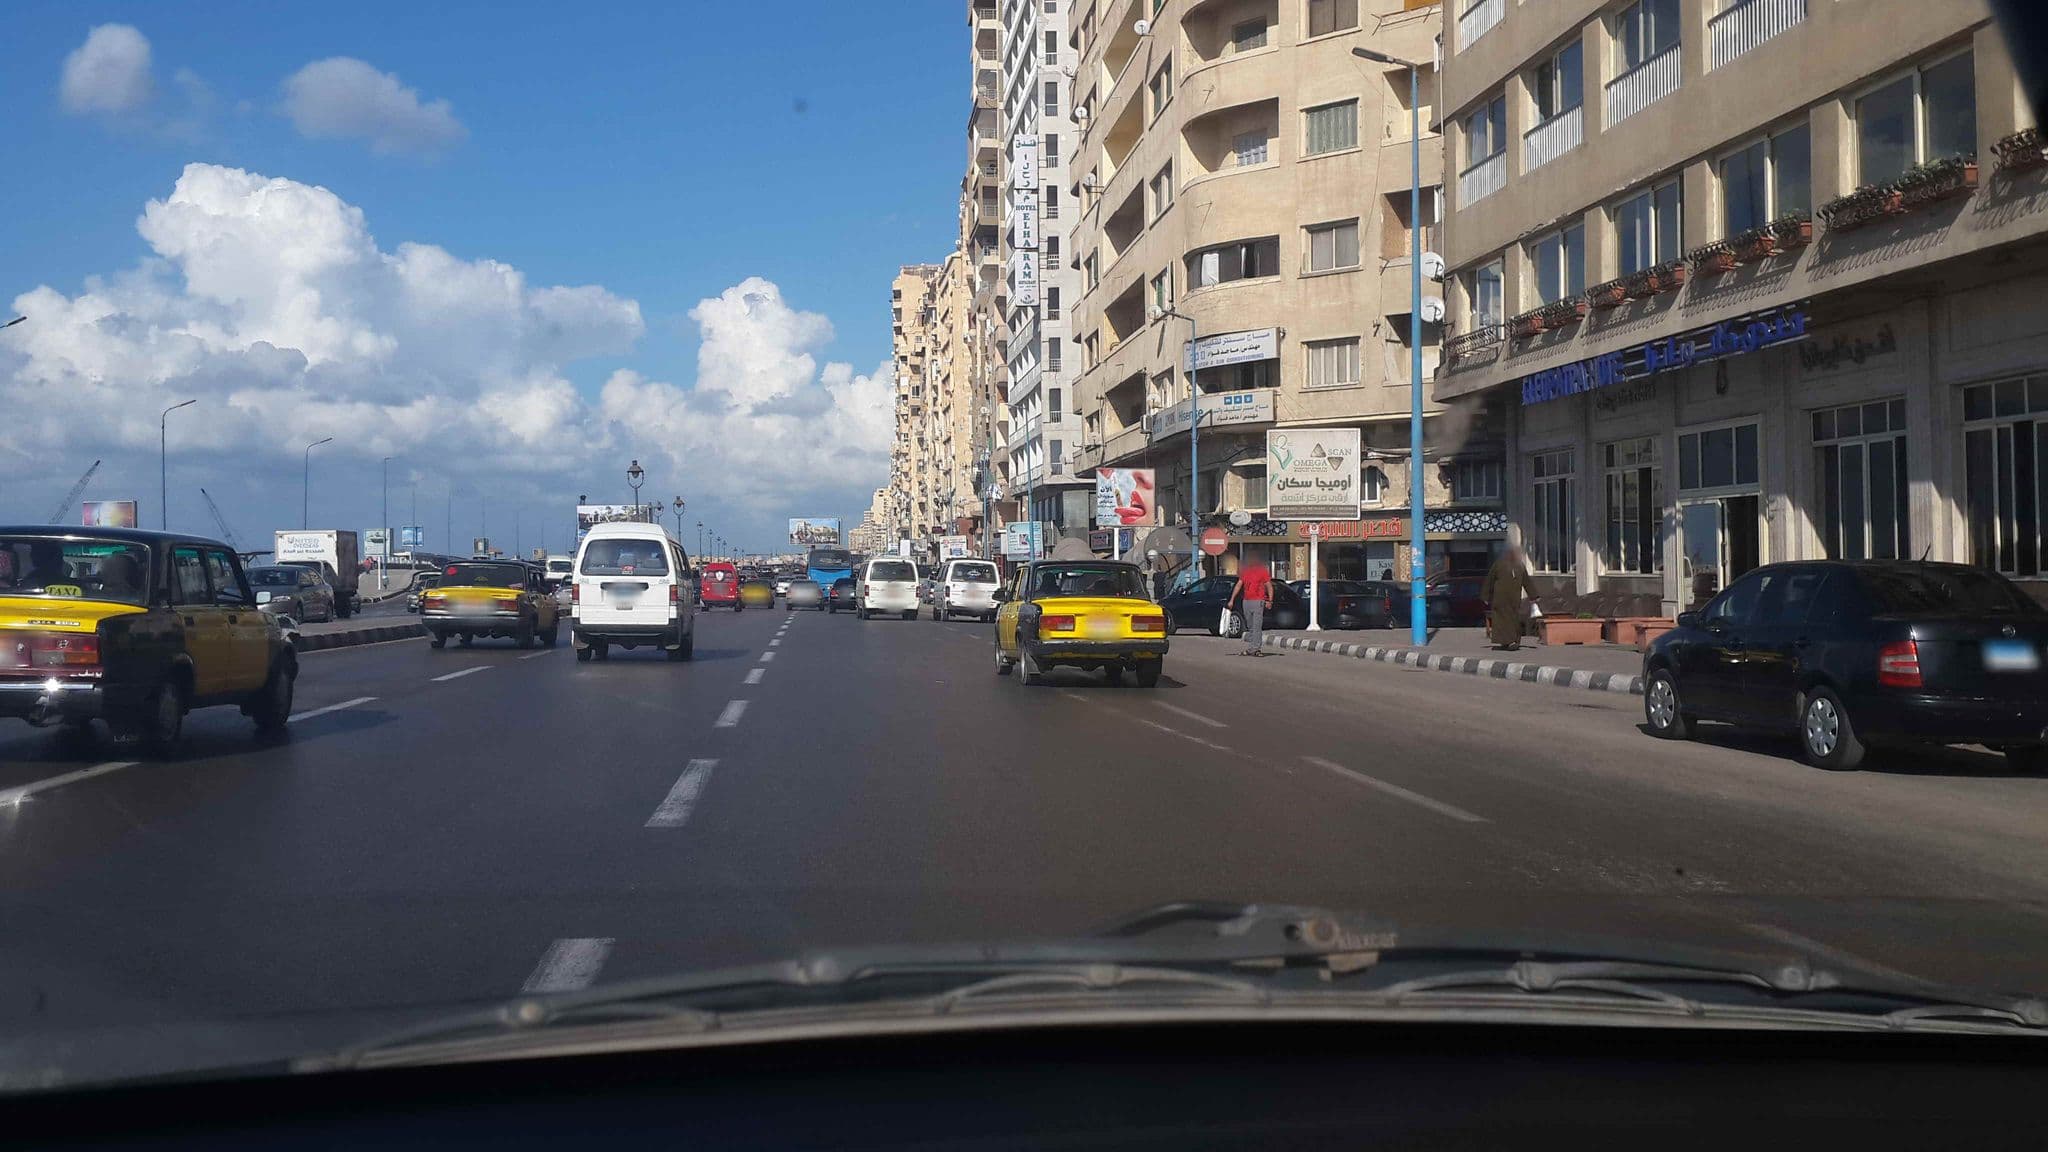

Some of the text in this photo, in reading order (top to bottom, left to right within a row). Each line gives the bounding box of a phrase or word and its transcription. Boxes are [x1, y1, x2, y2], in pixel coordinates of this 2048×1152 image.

[1016, 139, 1036, 148] فندق
[1327, 448, 1352, 456] SCAN
[1293, 459, 1328, 467] OMEGA
[1277, 474, 1352, 491] أوميجا سكان
[1305, 494, 1328, 503] مركز
[1362, 517, 1402, 540] قصر
[48, 587, 78, 595] TAXI
